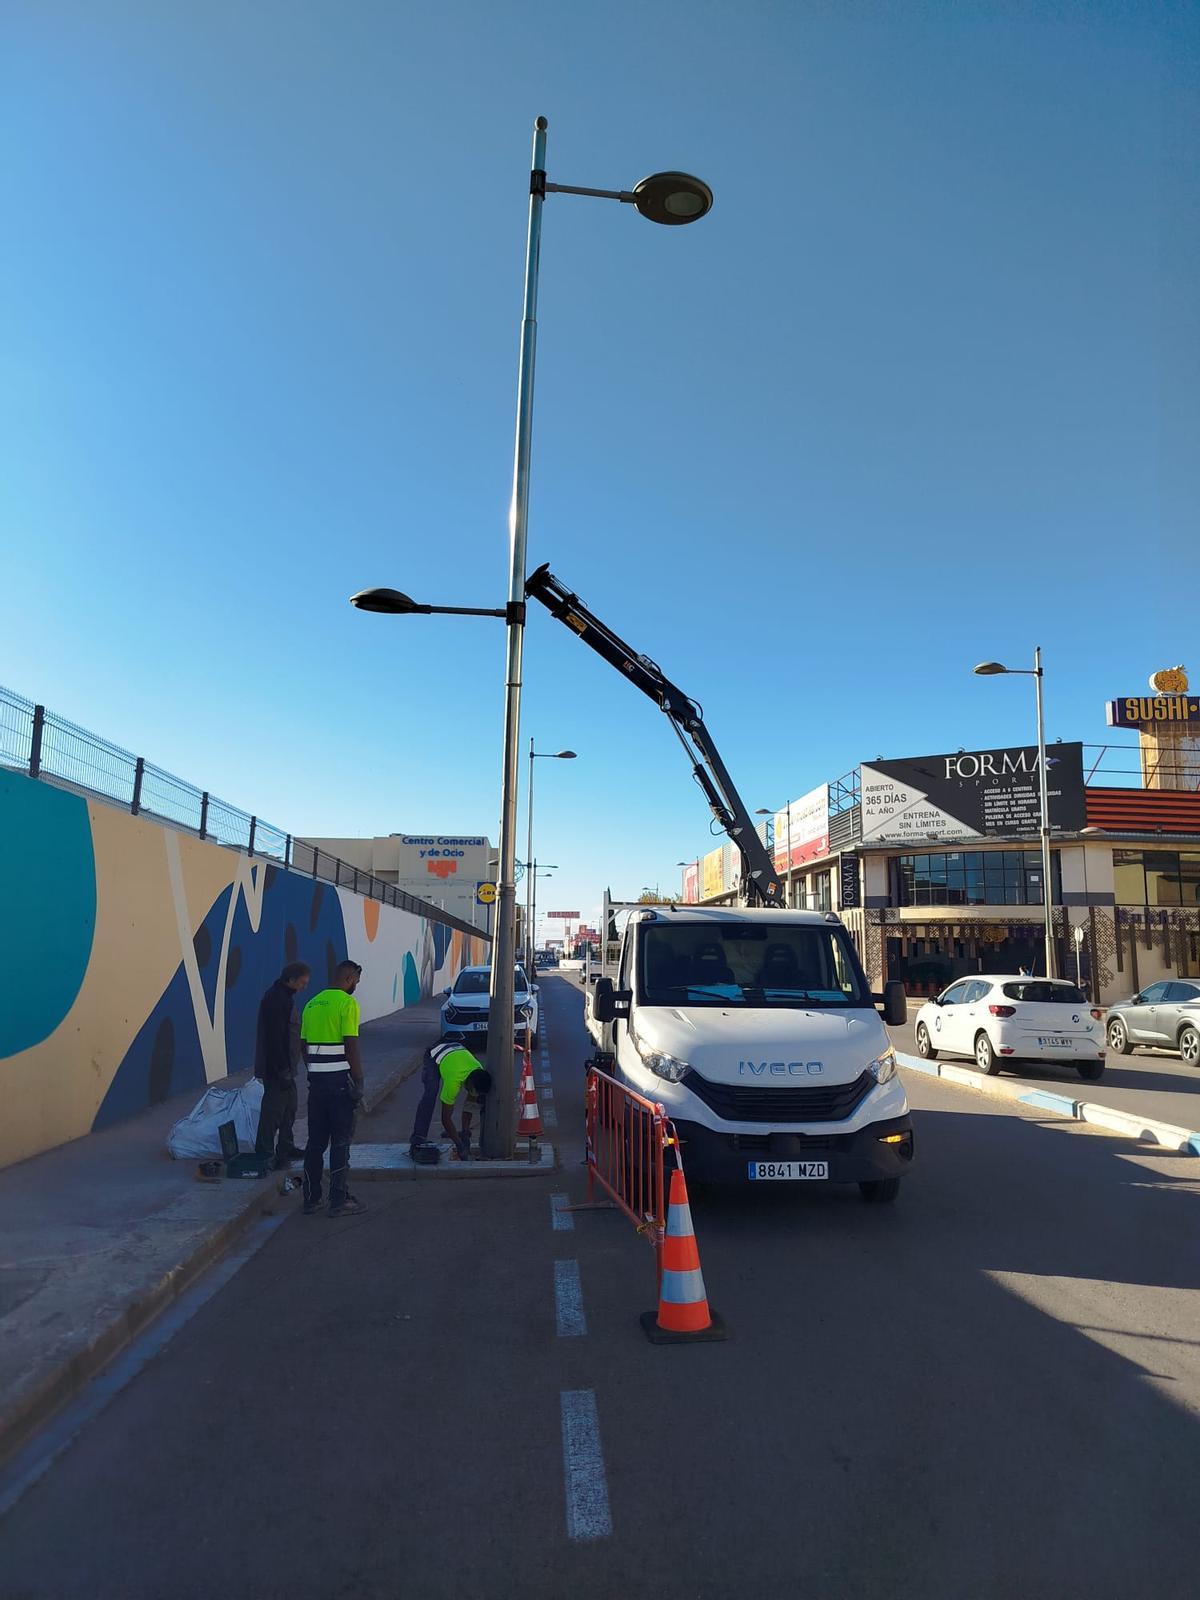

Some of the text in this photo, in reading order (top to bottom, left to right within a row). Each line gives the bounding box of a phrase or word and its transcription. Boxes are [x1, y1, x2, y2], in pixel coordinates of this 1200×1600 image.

[1126, 698, 1188, 720] SUSHI
[944, 751, 1052, 780] FORMA
[959, 776, 1035, 788] SPORT
[865, 784, 894, 793] ABIERTO
[866, 793, 907, 805] 365 DÍAS
[878, 806, 894, 814] AÑO
[903, 811, 941, 820] ENTRENA
[916, 818, 946, 828] LÍMITES
[885, 828, 963, 838] www.forma-sport.com
[402, 837, 484, 846] Centro Comercial
[420, 850, 426, 858] y
[843, 864, 854, 905] FORMA
[739, 1061, 824, 1076] IVECO
[758, 1164, 826, 1177] 8841 MZD
